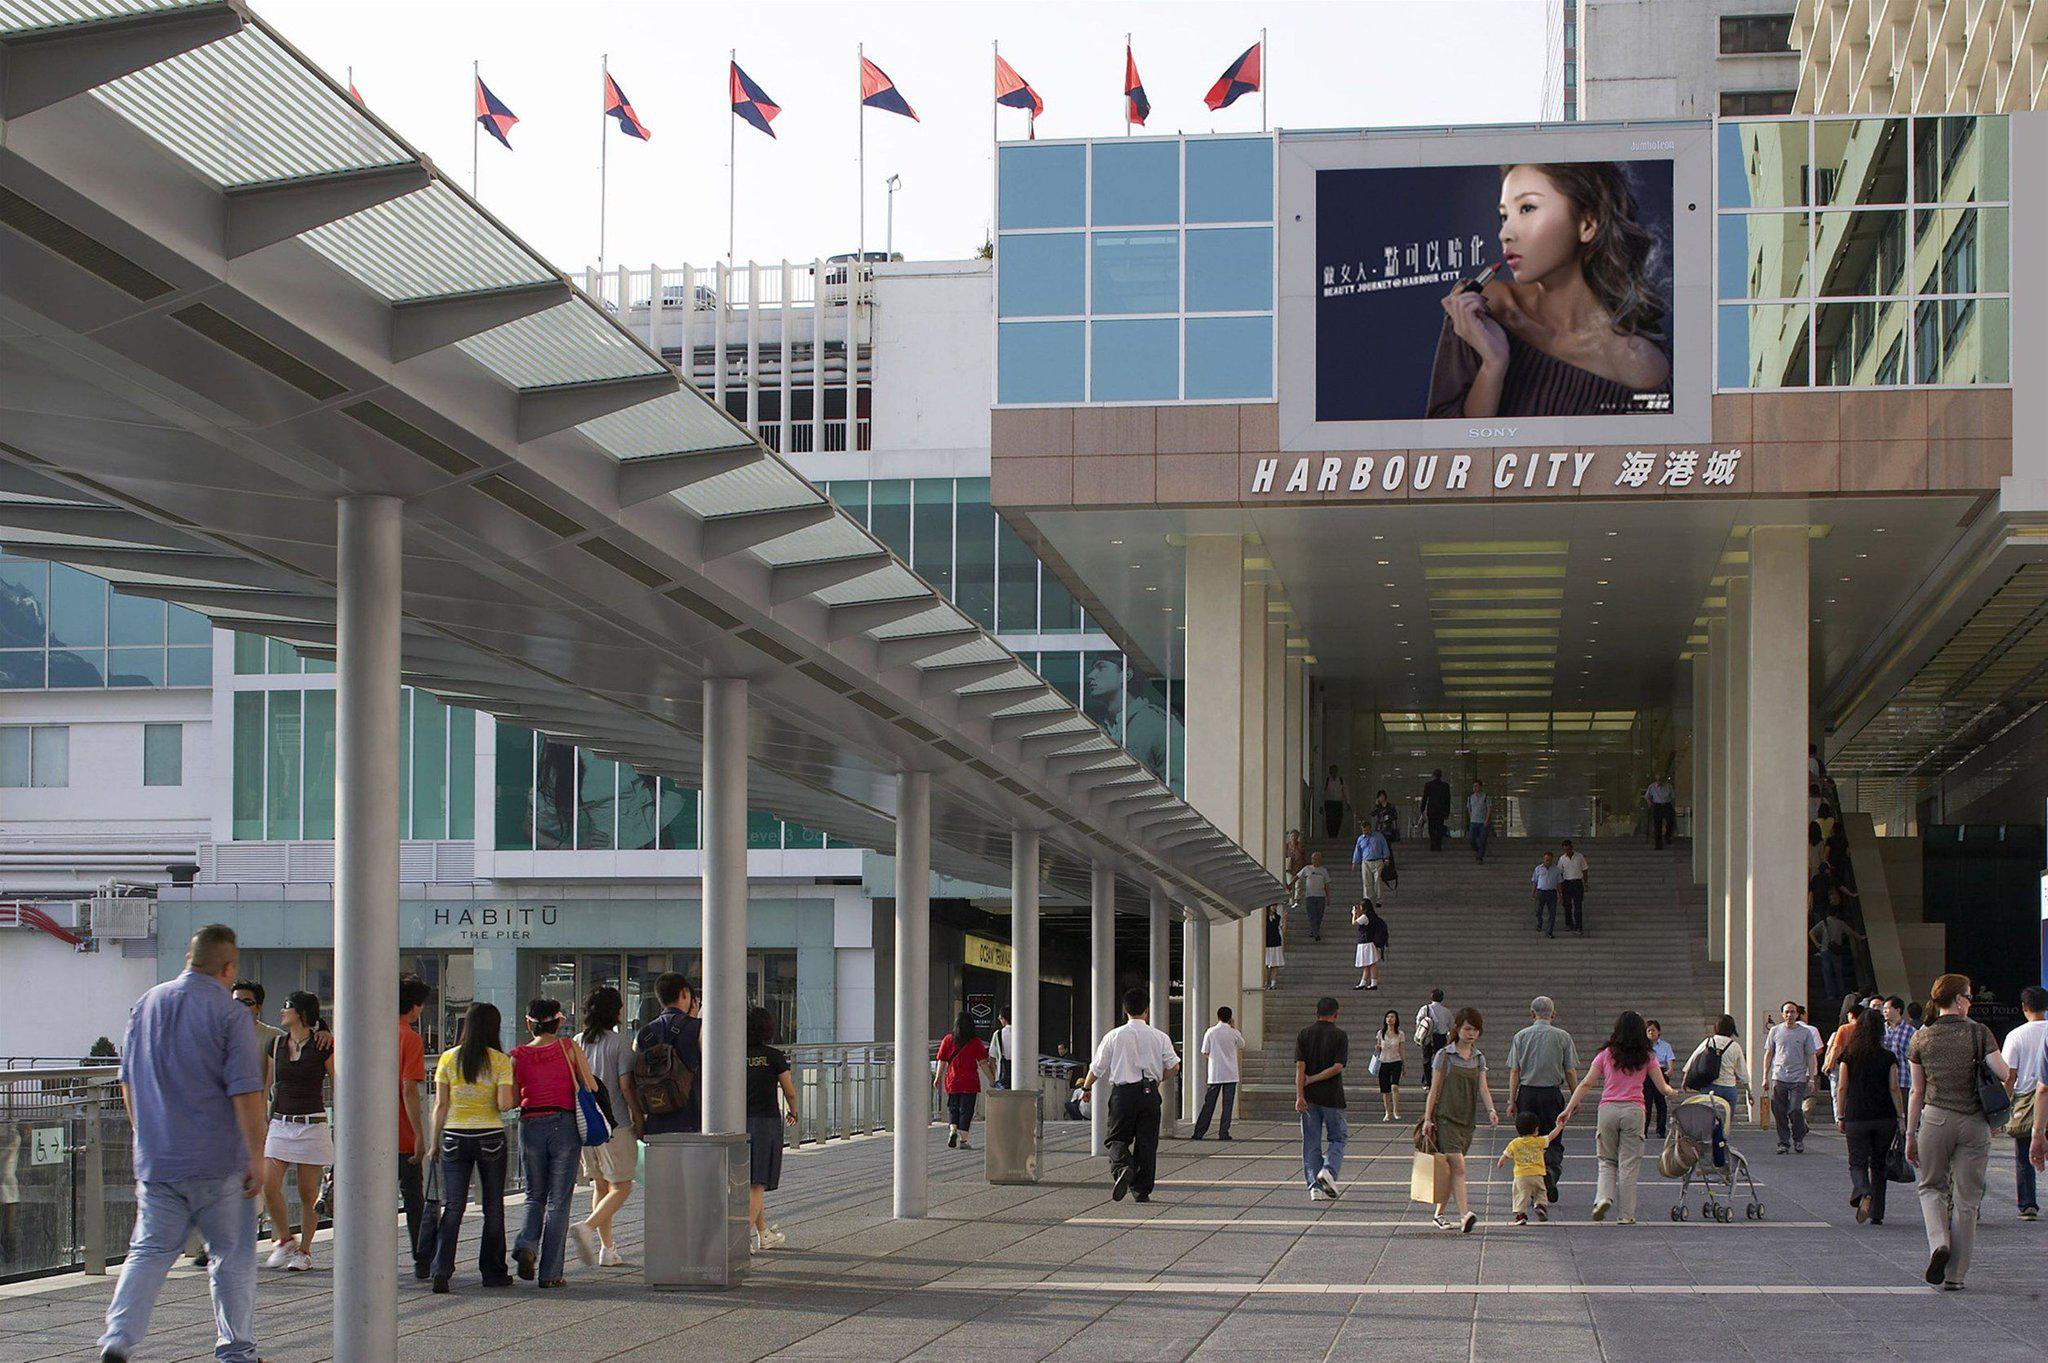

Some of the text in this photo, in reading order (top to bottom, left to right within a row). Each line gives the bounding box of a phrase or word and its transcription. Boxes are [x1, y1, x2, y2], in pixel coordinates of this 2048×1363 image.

[1323, 284, 1355, 298] BEAUTY
[1440, 270, 1460, 281] CITY
[1468, 428, 1517, 438] SONY
[1252, 448, 1742, 492] HARBOUR CITY 海港城
[786, 828, 794, 841] 3
[460, 931, 531, 939] THE PIER
